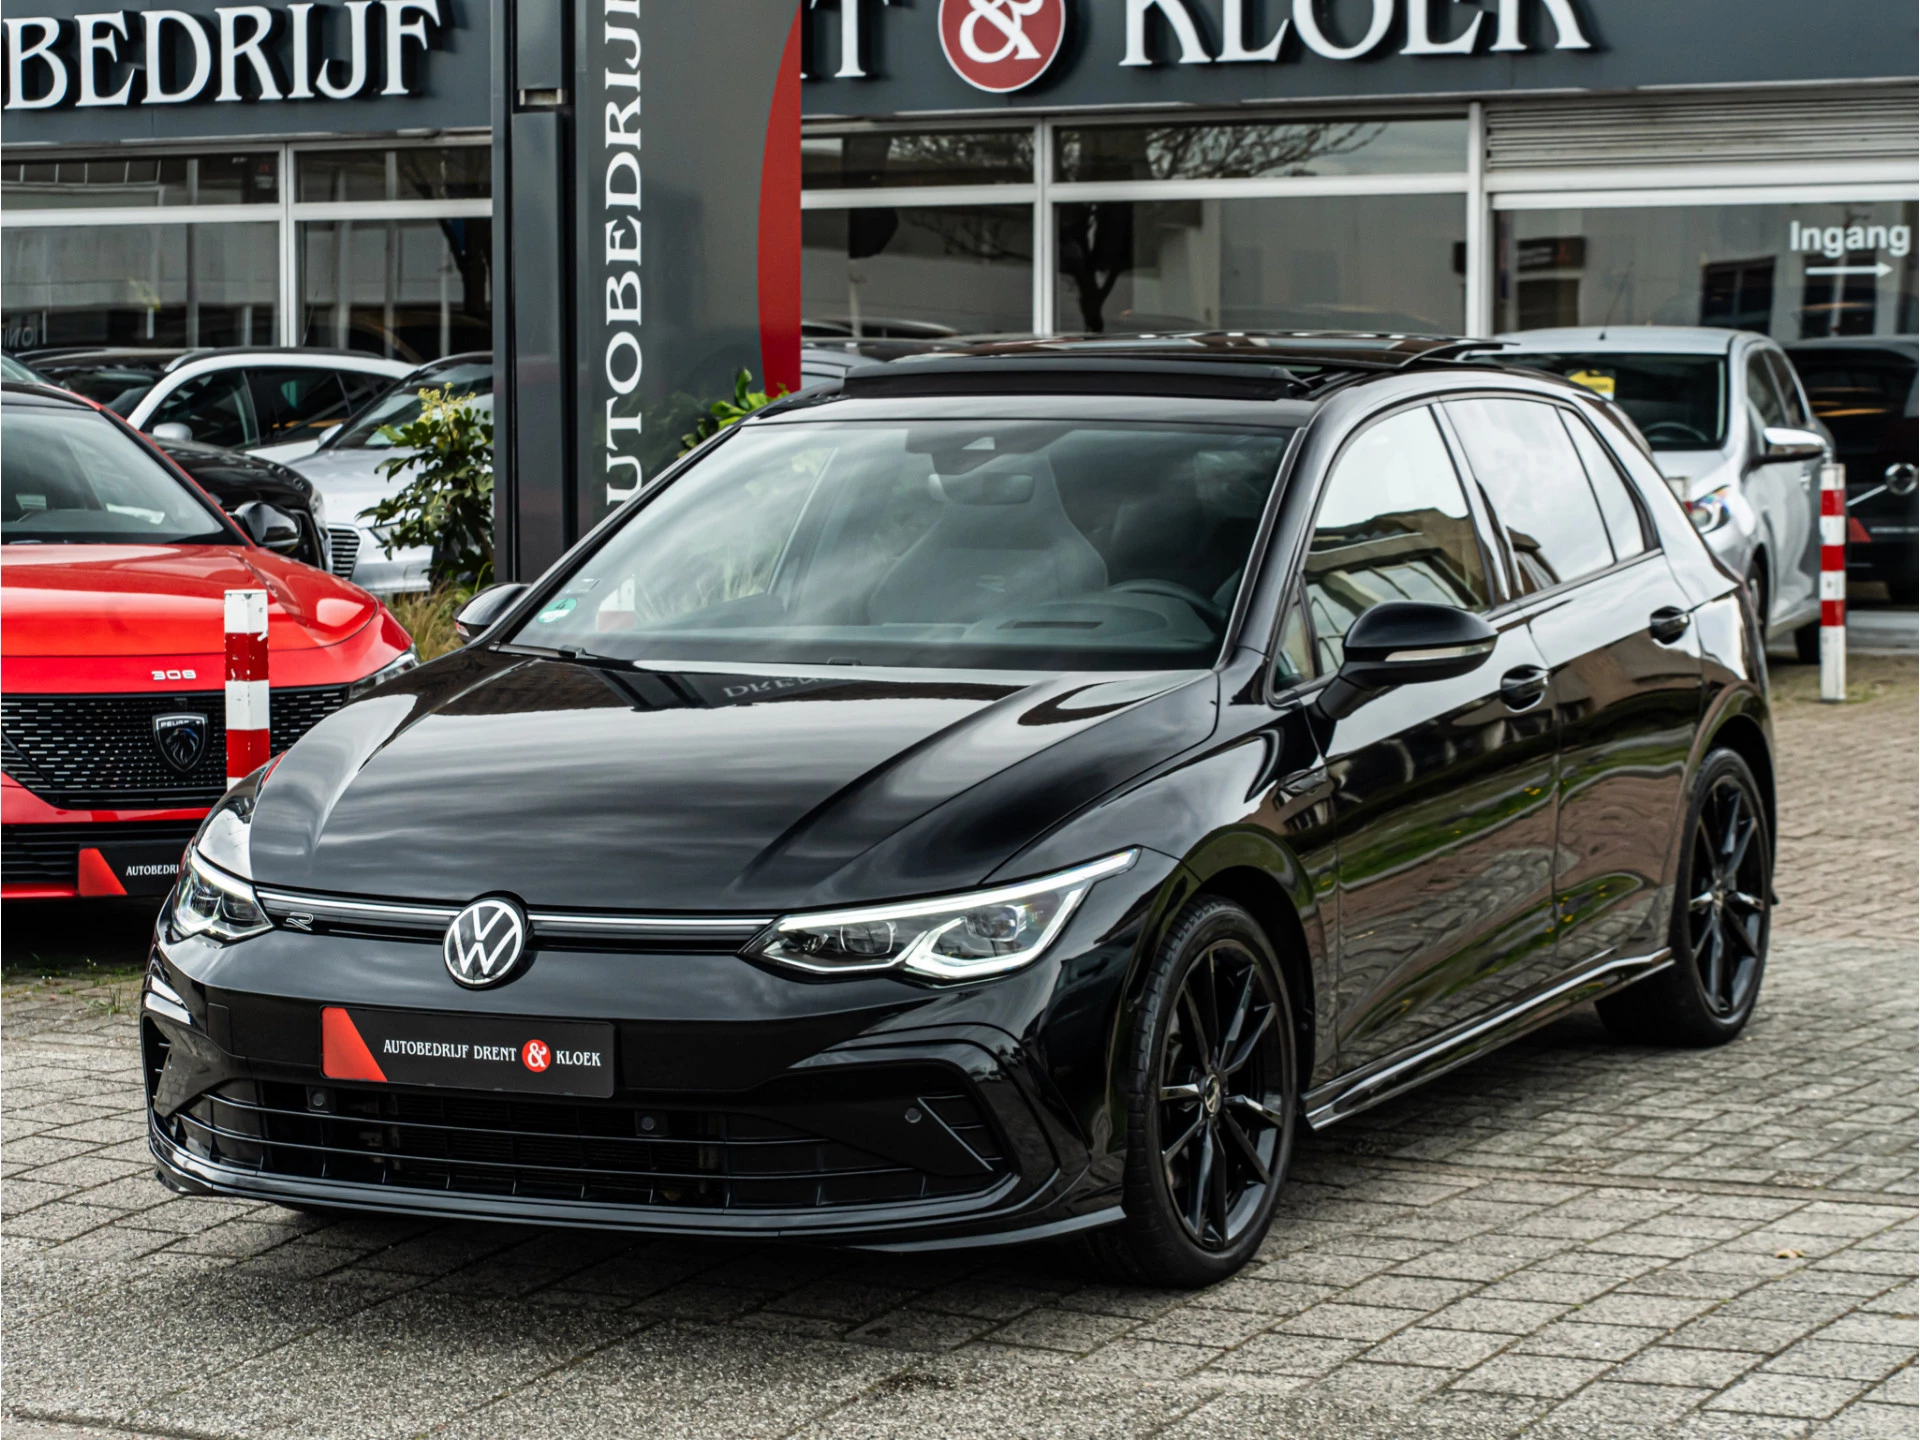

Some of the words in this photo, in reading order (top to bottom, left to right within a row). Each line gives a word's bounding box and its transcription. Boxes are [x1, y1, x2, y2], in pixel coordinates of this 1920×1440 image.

[3, 0, 441, 110] BEDRIJF
[959, 0, 1043, 63] &
[1118, 0, 1592, 67] KLOEK
[1790, 220, 1911, 258] Ingang
[151, 669, 197, 681] 308
[125, 864, 180, 877] AUTOBEDRI
[383, 1039, 470, 1058] AUTOBEDRIJF
[473, 1045, 517, 1062] DRENT
[527, 1042, 547, 1068] &
[556, 1050, 602, 1067] KLOEK
